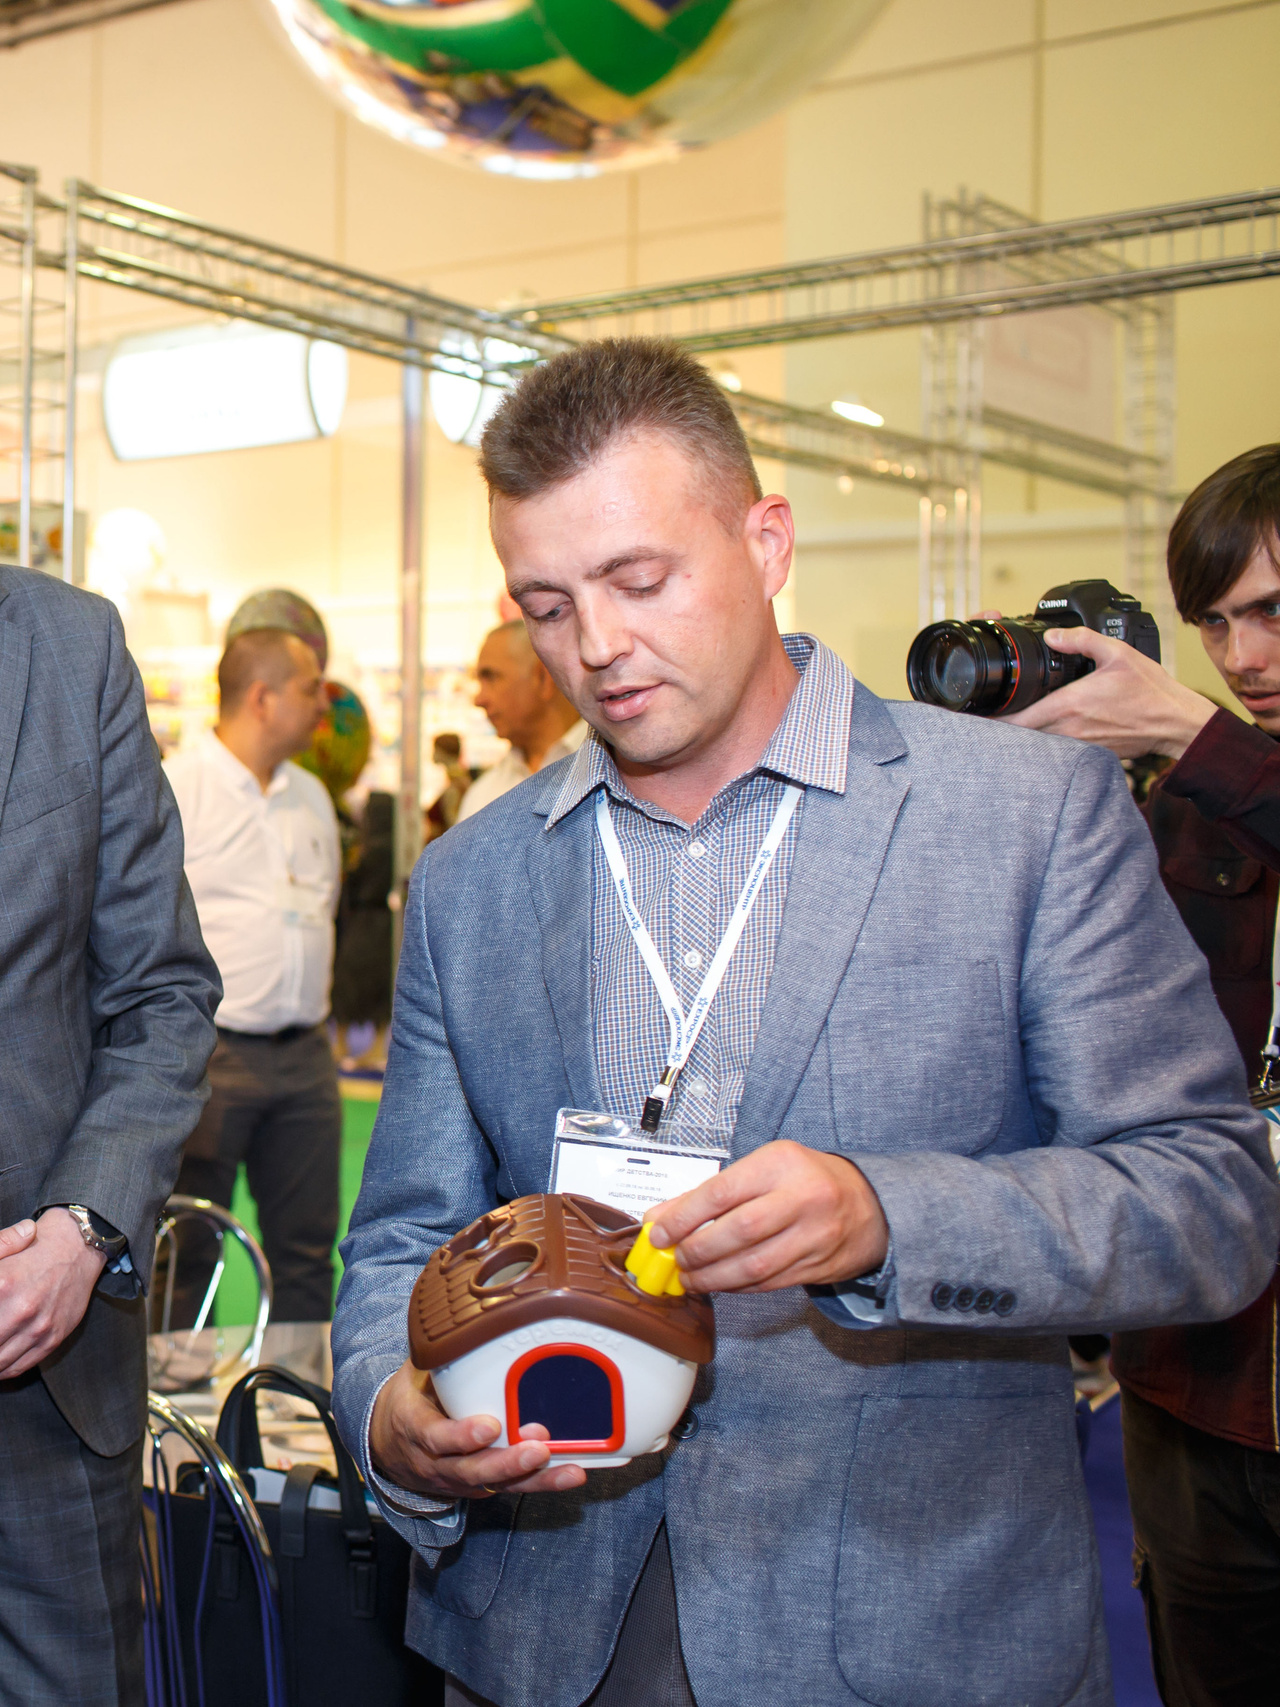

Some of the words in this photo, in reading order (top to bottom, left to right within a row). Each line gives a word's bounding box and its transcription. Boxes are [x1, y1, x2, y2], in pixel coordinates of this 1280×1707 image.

[1038, 599, 1068, 609] Canon
[1106, 618, 1123, 627] EOS
[501, 1321, 624, 1352] теремок
